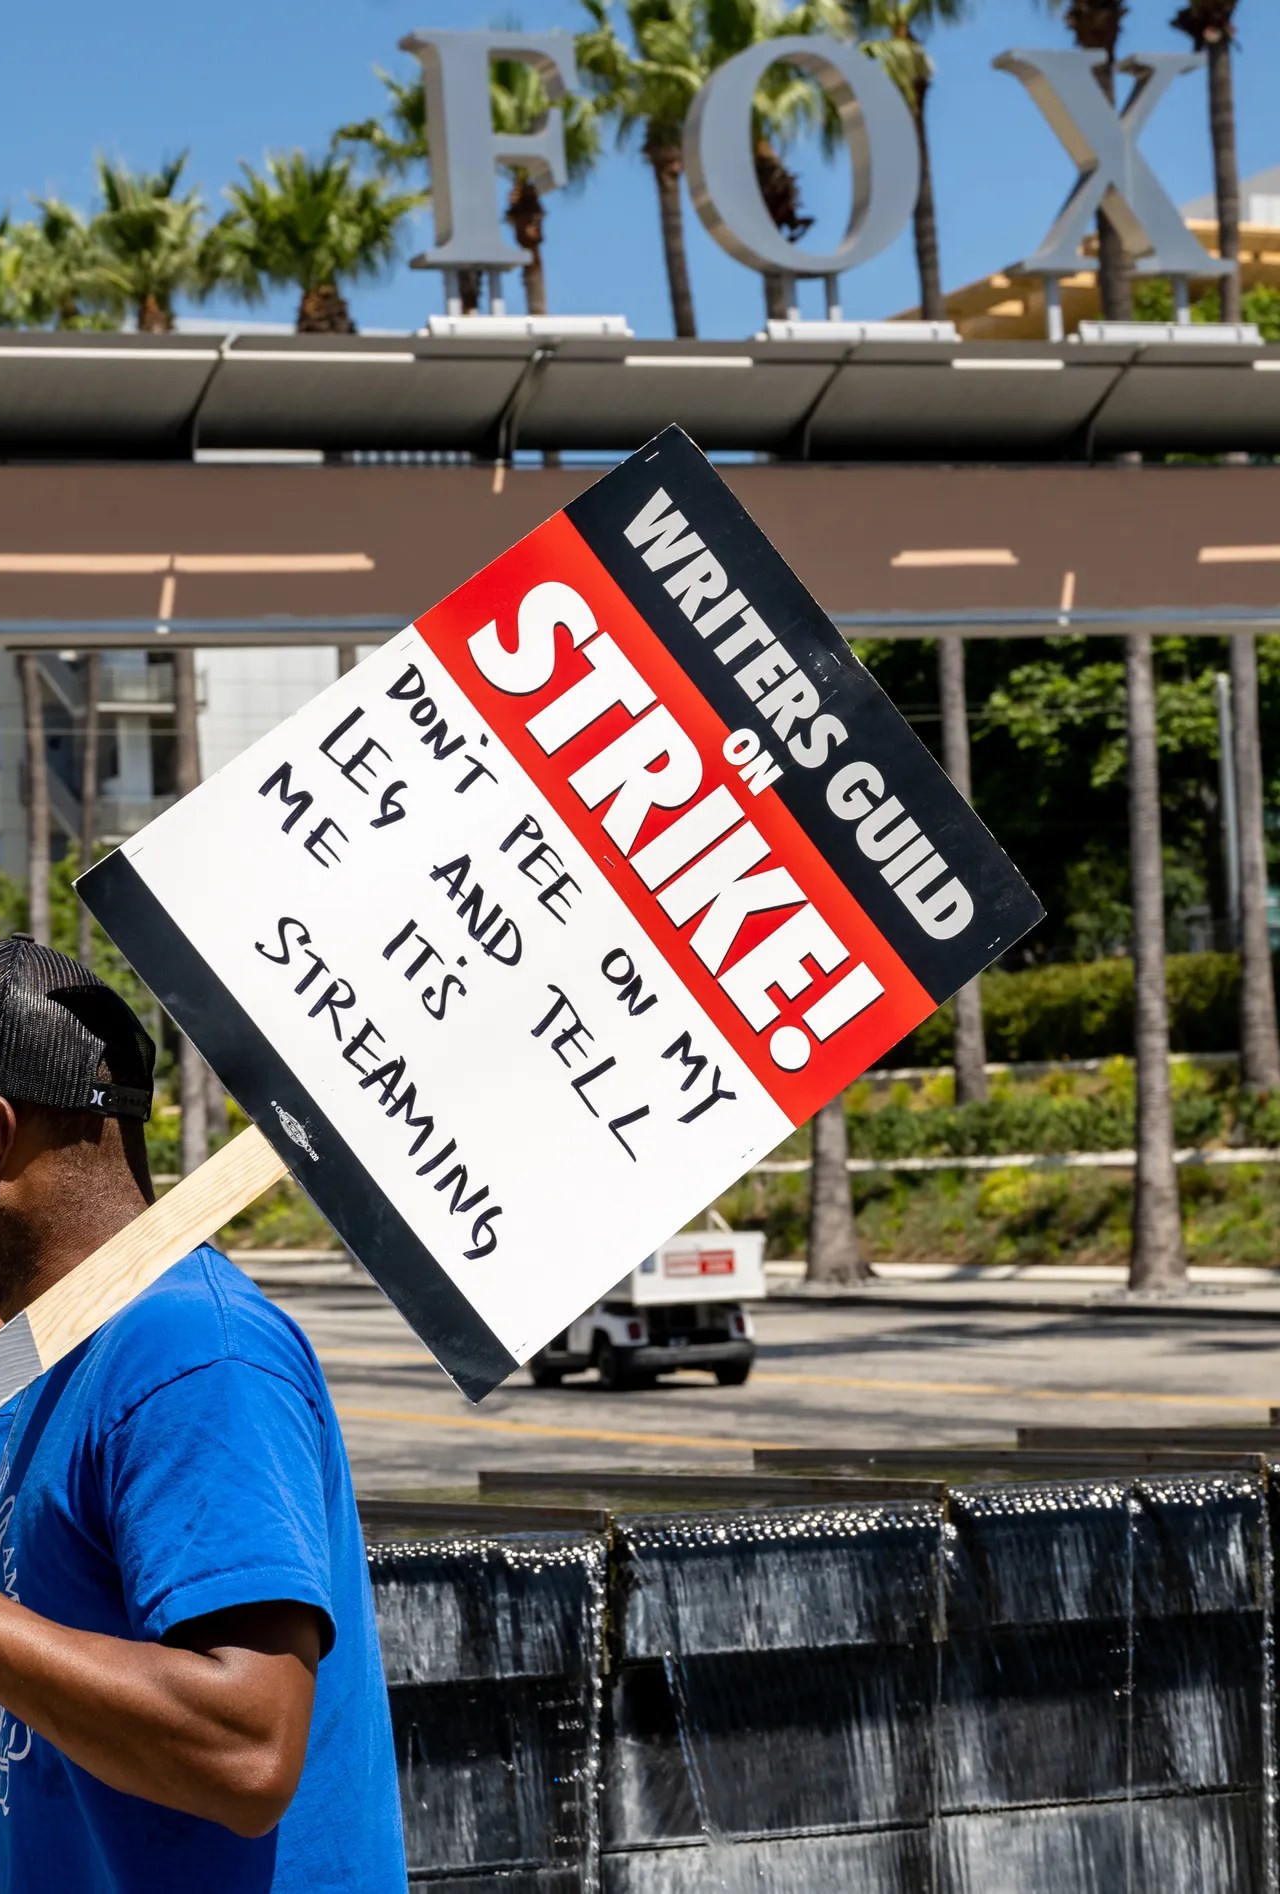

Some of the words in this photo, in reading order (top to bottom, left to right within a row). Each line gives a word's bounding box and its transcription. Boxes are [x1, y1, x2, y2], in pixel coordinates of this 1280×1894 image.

[399, 28, 1236, 278] FOX
[258, 761, 349, 868] ME
[382, 919, 467, 1021] IT'S
[385, 663, 498, 794] DON'T
[499, 814, 582, 925] PEE
[601, 947, 658, 1017] ON
[660, 1030, 737, 1124] MY
[466, 580, 887, 1071] STRIKE!
[623, 486, 849, 769] WRITERS
[825, 761, 974, 940] GUILD
[721, 727, 778, 797] ON
[254, 916, 503, 1260] STREAMING
[318, 706, 408, 829] LEG
[429, 853, 522, 967] AND
[530, 984, 650, 1162] TELL
